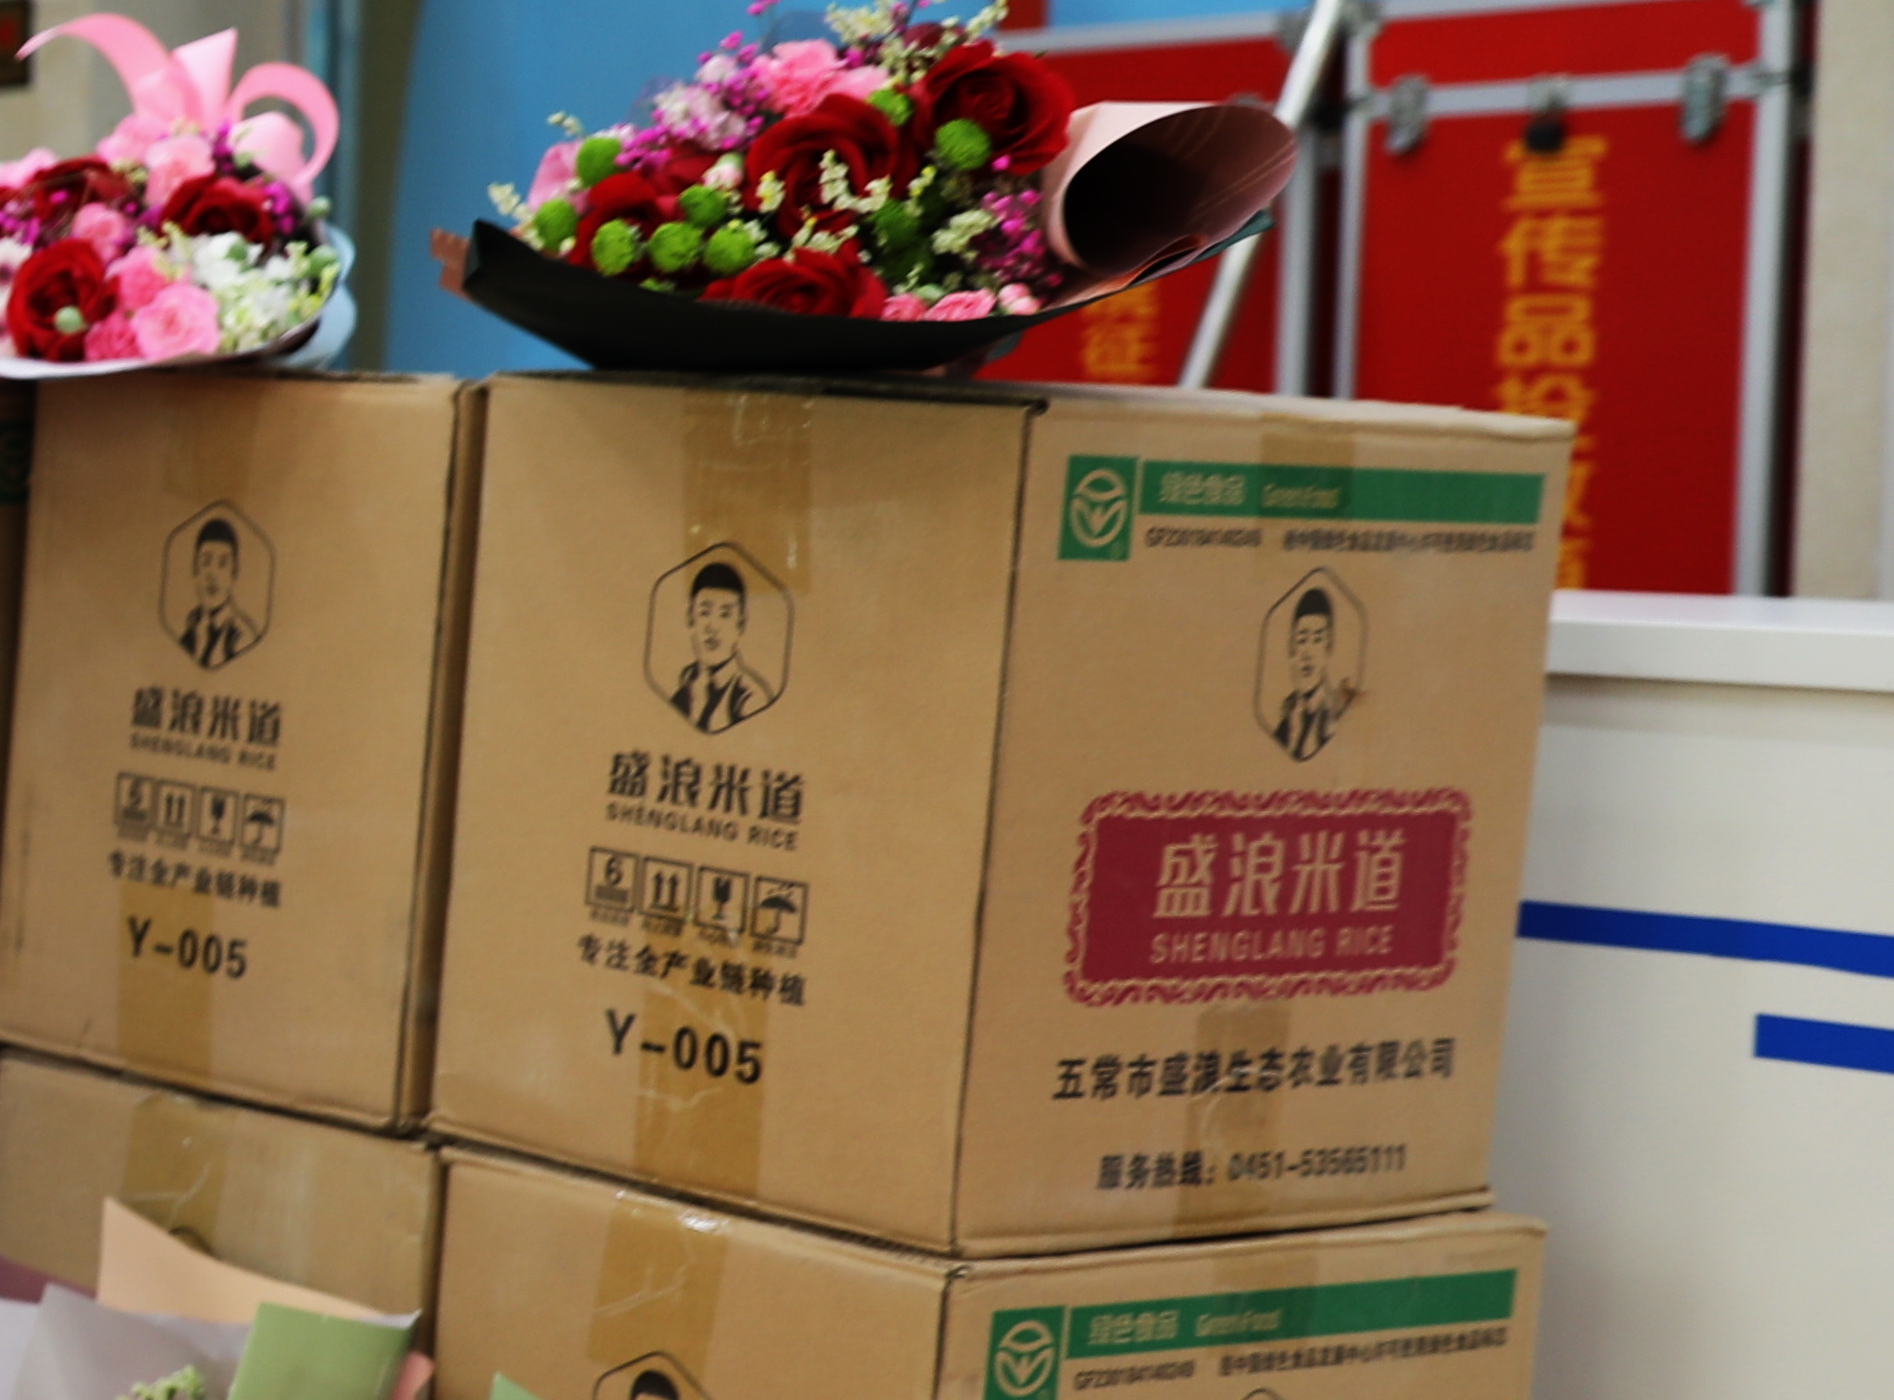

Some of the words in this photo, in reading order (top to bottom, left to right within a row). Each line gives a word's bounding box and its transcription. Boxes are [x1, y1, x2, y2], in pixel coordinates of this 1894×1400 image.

[132, 686, 282, 747] 盛浪米道
[608, 751, 806, 826] 盛浪米道
[606, 803, 740, 843] SHENGLANG
[747, 827, 800, 851] RICE
[1153, 828, 1407, 920] 盛浪米道
[128, 916, 249, 979] Y-005
[1149, 927, 1327, 964] SHENGLANG
[1336, 924, 1394, 956] RICE
[605, 1009, 764, 1085] Y-005
